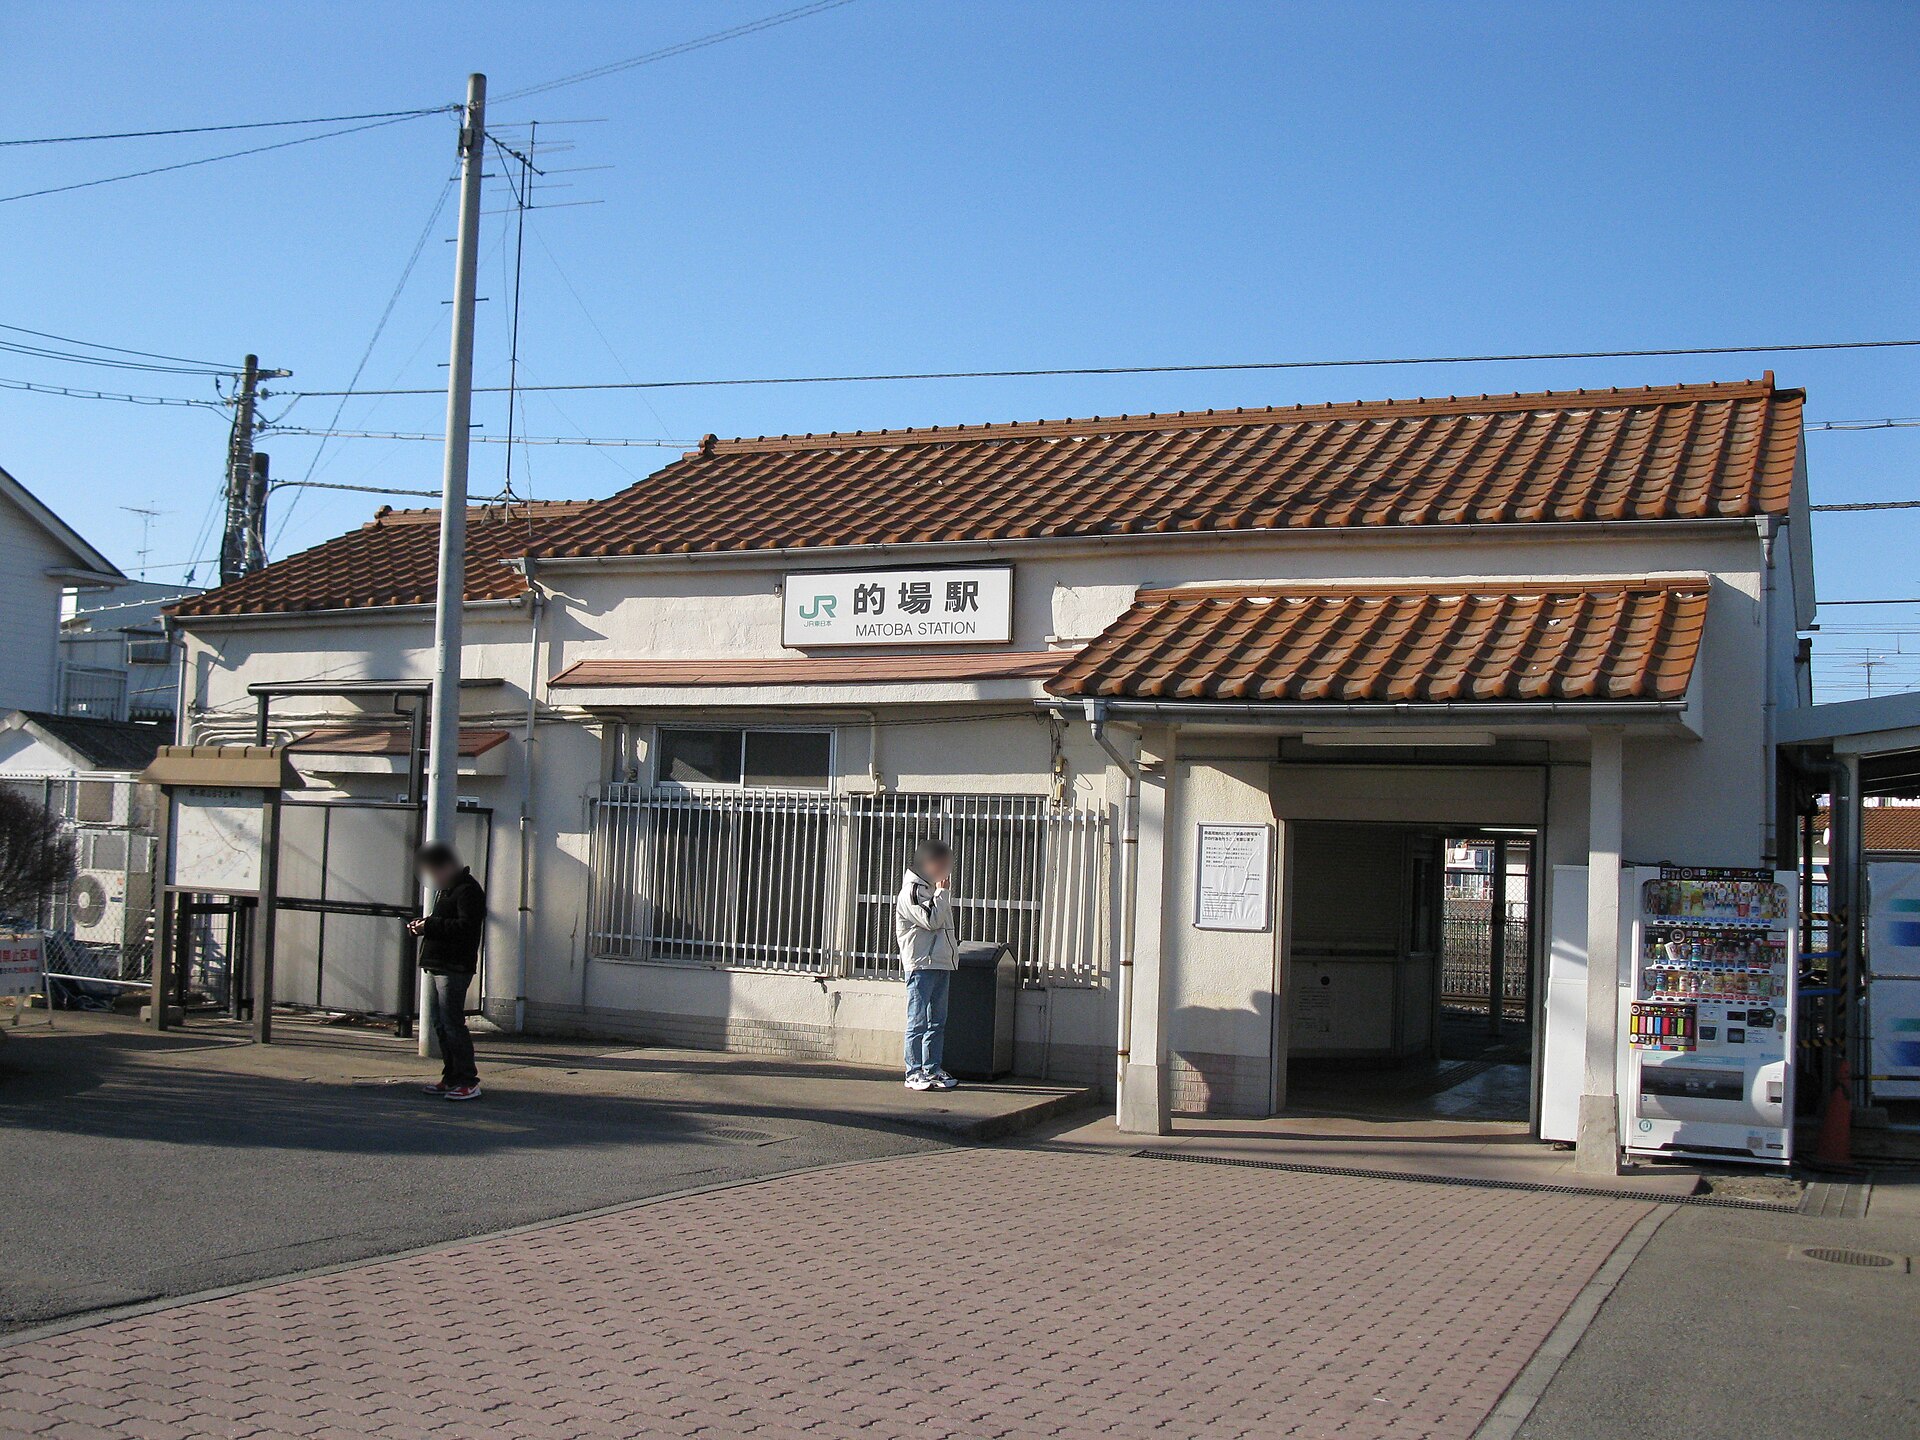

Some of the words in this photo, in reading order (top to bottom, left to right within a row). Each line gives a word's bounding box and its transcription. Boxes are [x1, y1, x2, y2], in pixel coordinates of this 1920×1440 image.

[799, 595, 837, 619] JR
[854, 581, 979, 616] 的場駅
[855, 623, 913, 637] MATOBA
[917, 621, 976, 636] STATION
